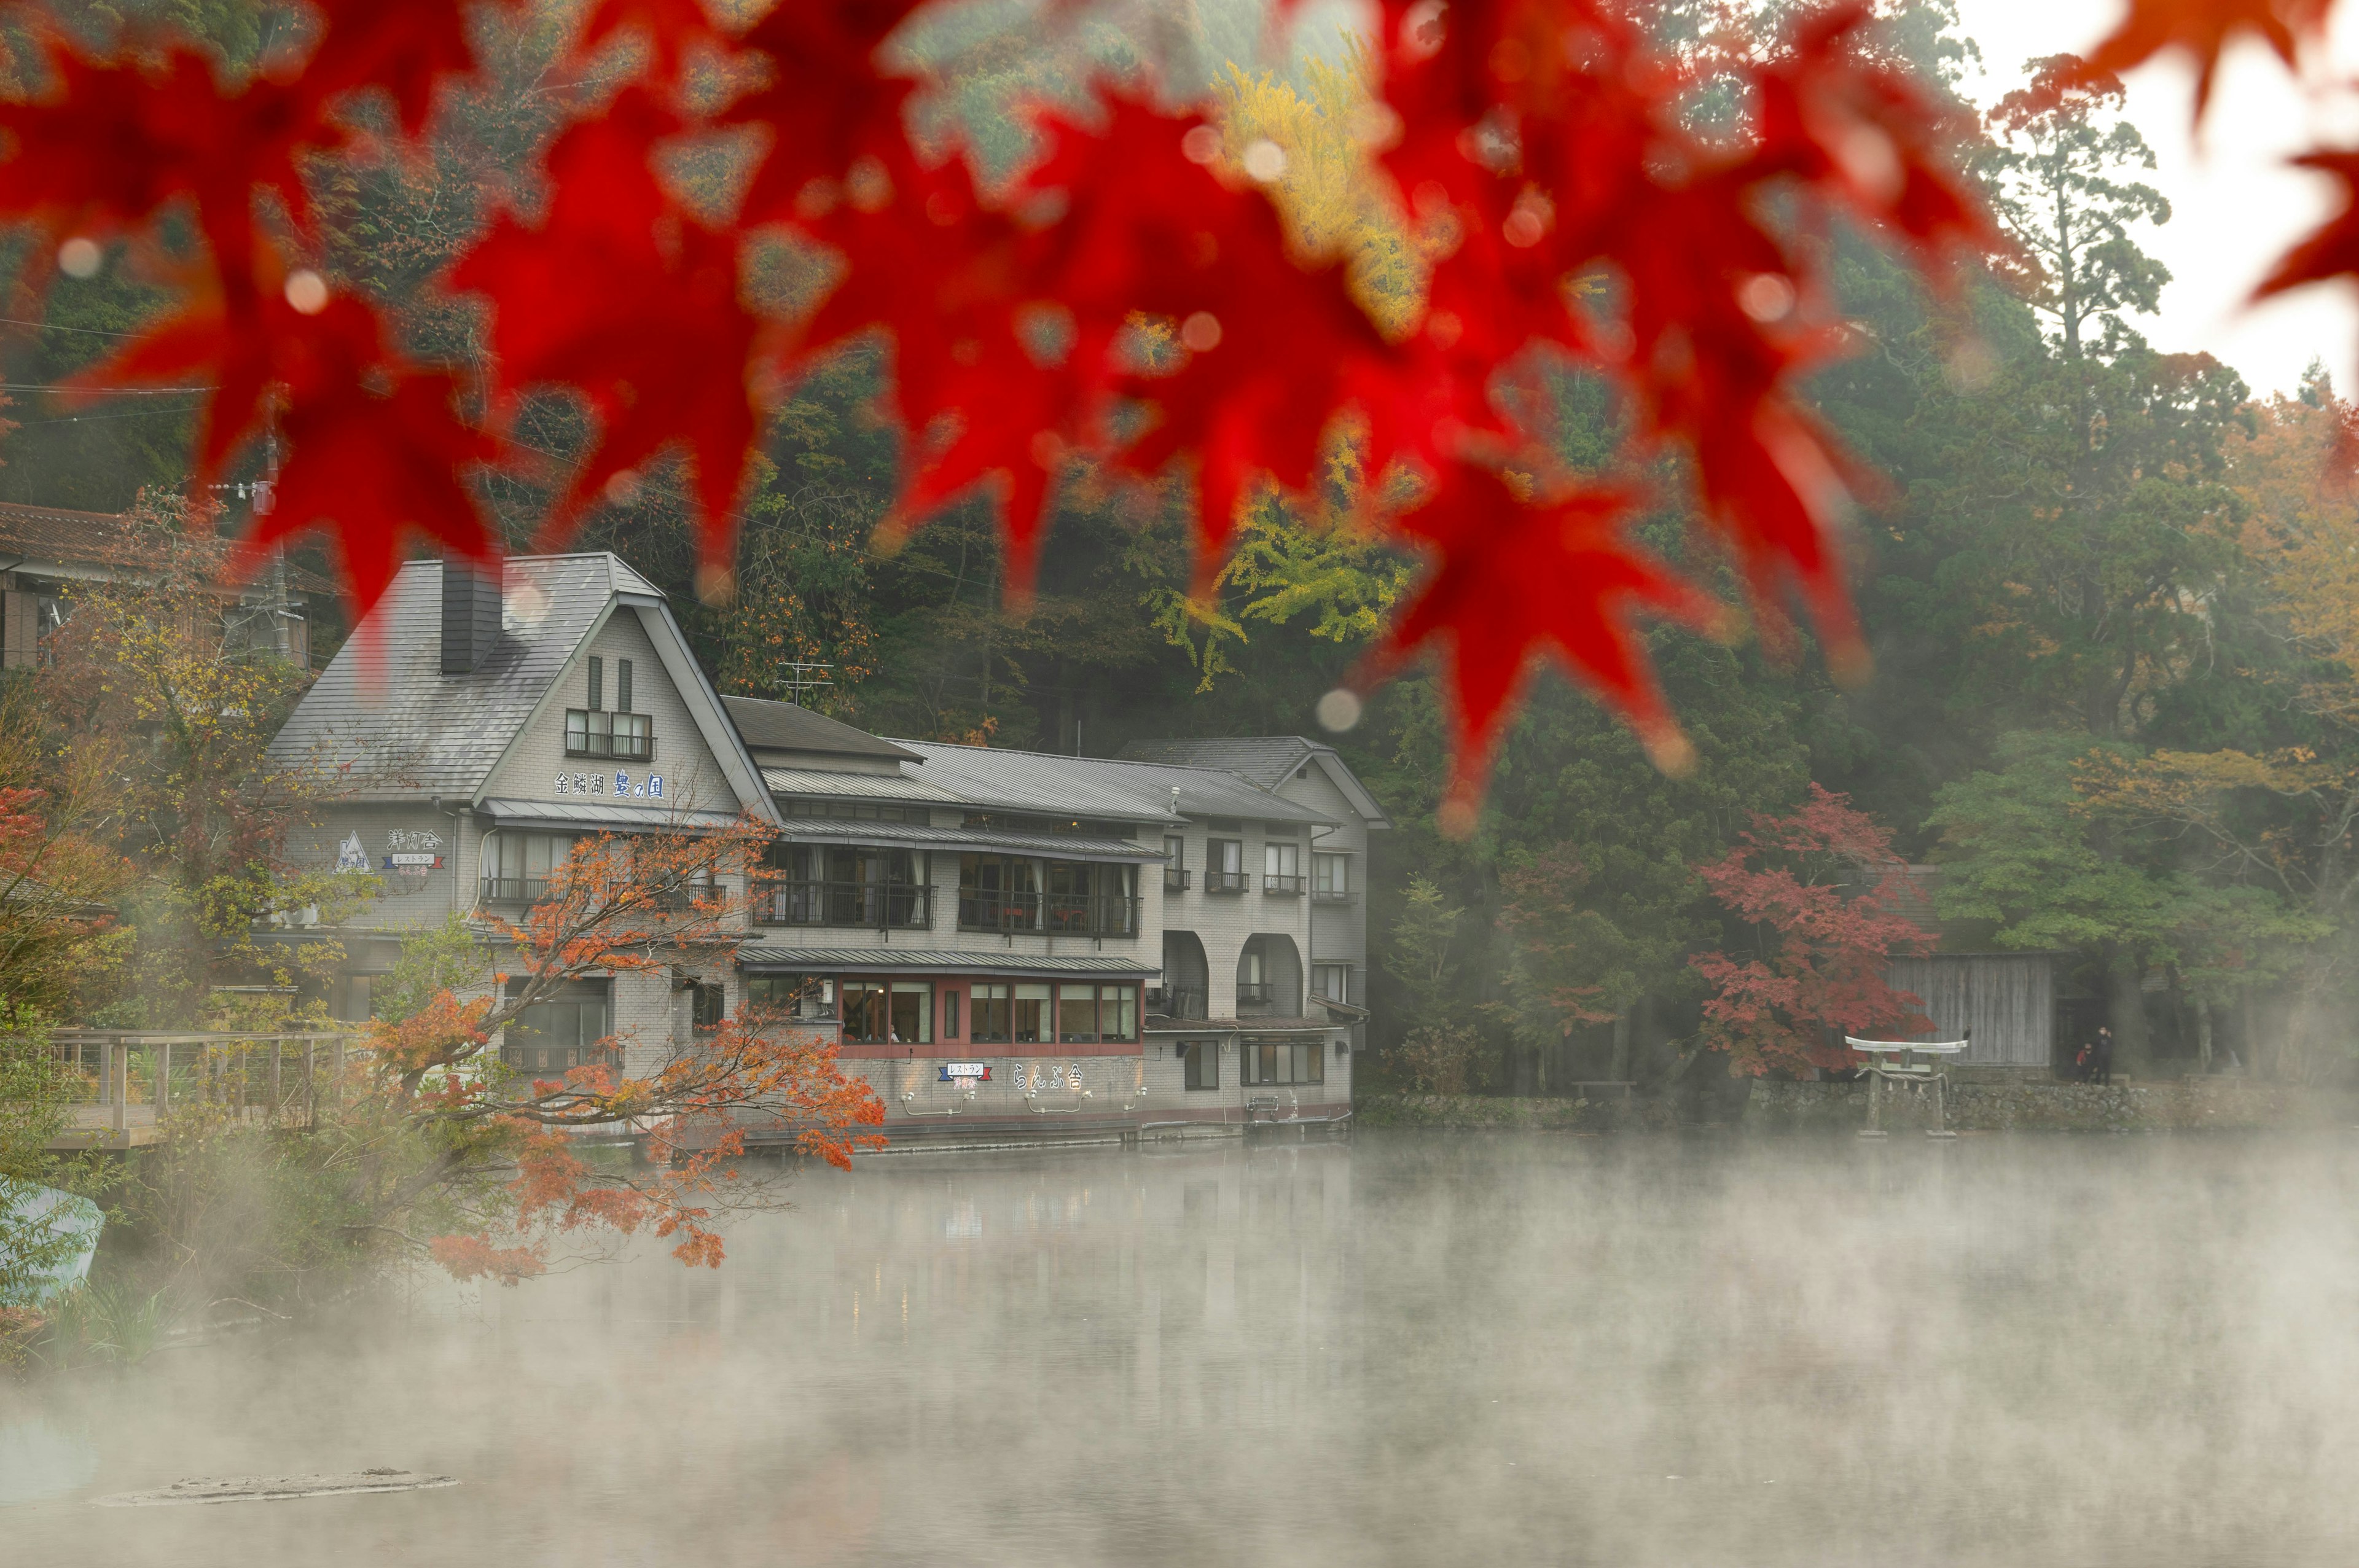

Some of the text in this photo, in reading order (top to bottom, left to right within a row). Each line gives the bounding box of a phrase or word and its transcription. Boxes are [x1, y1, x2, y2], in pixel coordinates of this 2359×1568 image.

[555, 768, 663, 799] 金鱗湖 豊の国
[387, 829, 444, 851] 洋灯舎
[950, 1064, 981, 1074] レストラン
[1014, 1063, 1082, 1090] らんぷ舎
